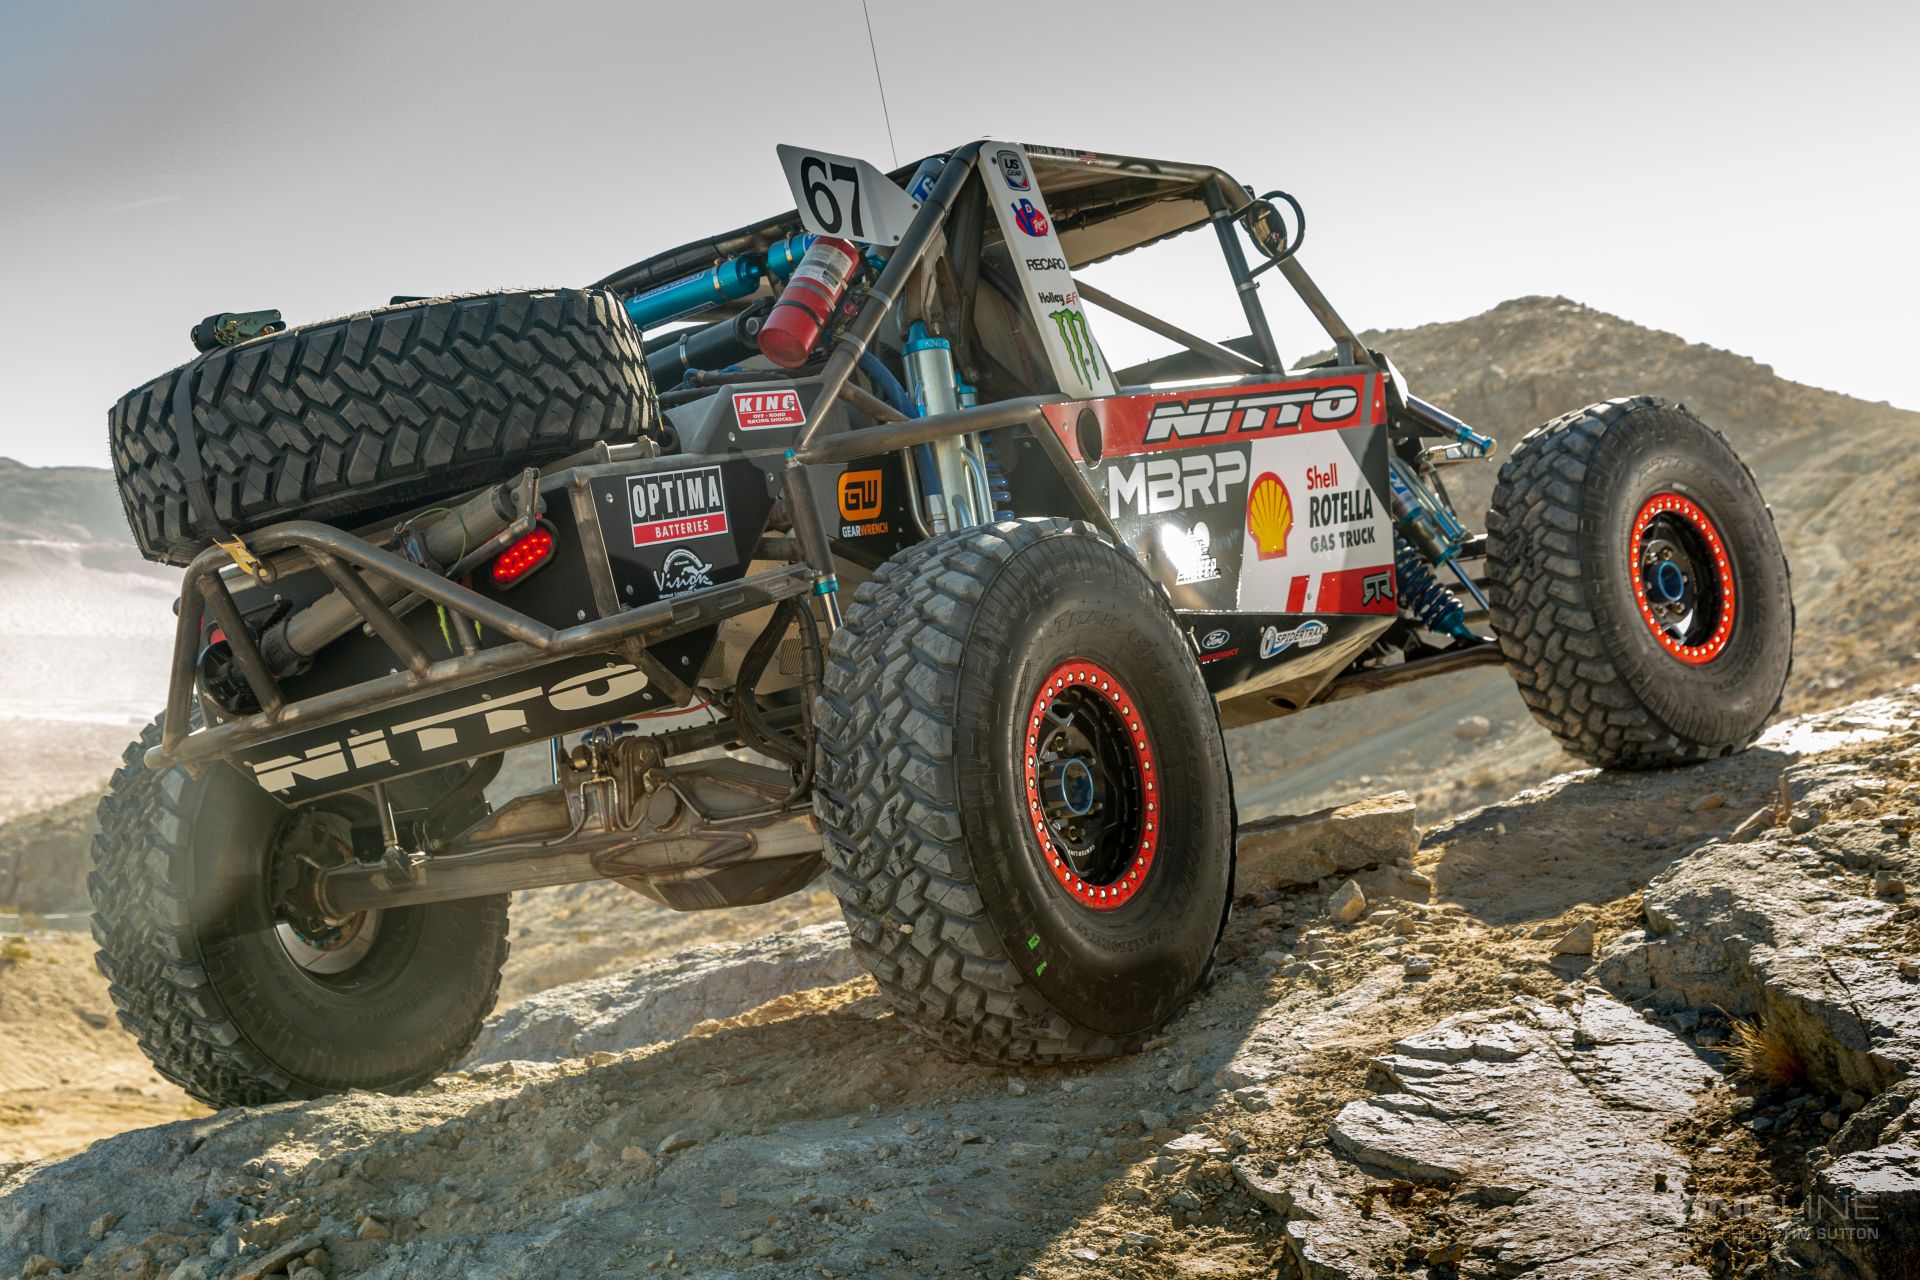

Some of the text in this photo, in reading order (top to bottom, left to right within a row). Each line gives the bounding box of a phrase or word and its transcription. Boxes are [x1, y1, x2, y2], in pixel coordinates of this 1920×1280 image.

[1004, 158, 1020, 170] US
[800, 156, 865, 238] 67
[1026, 258, 1066, 271] RECARO
[1038, 291, 1065, 306] Holley
[739, 394, 795, 413] KING
[1145, 388, 1357, 442] NITTO
[1108, 450, 1248, 519] MBRP
[1306, 462, 1339, 490] Shell
[632, 475, 721, 518] OPTIMA
[844, 479, 878, 511] GW
[1309, 488, 1374, 528] ROTELLA
[655, 519, 710, 539] BATTERIES
[841, 522, 889, 538] GEARWRENCH
[1310, 526, 1376, 554] GAS TRUCK
[253, 664, 649, 793] NITTO
